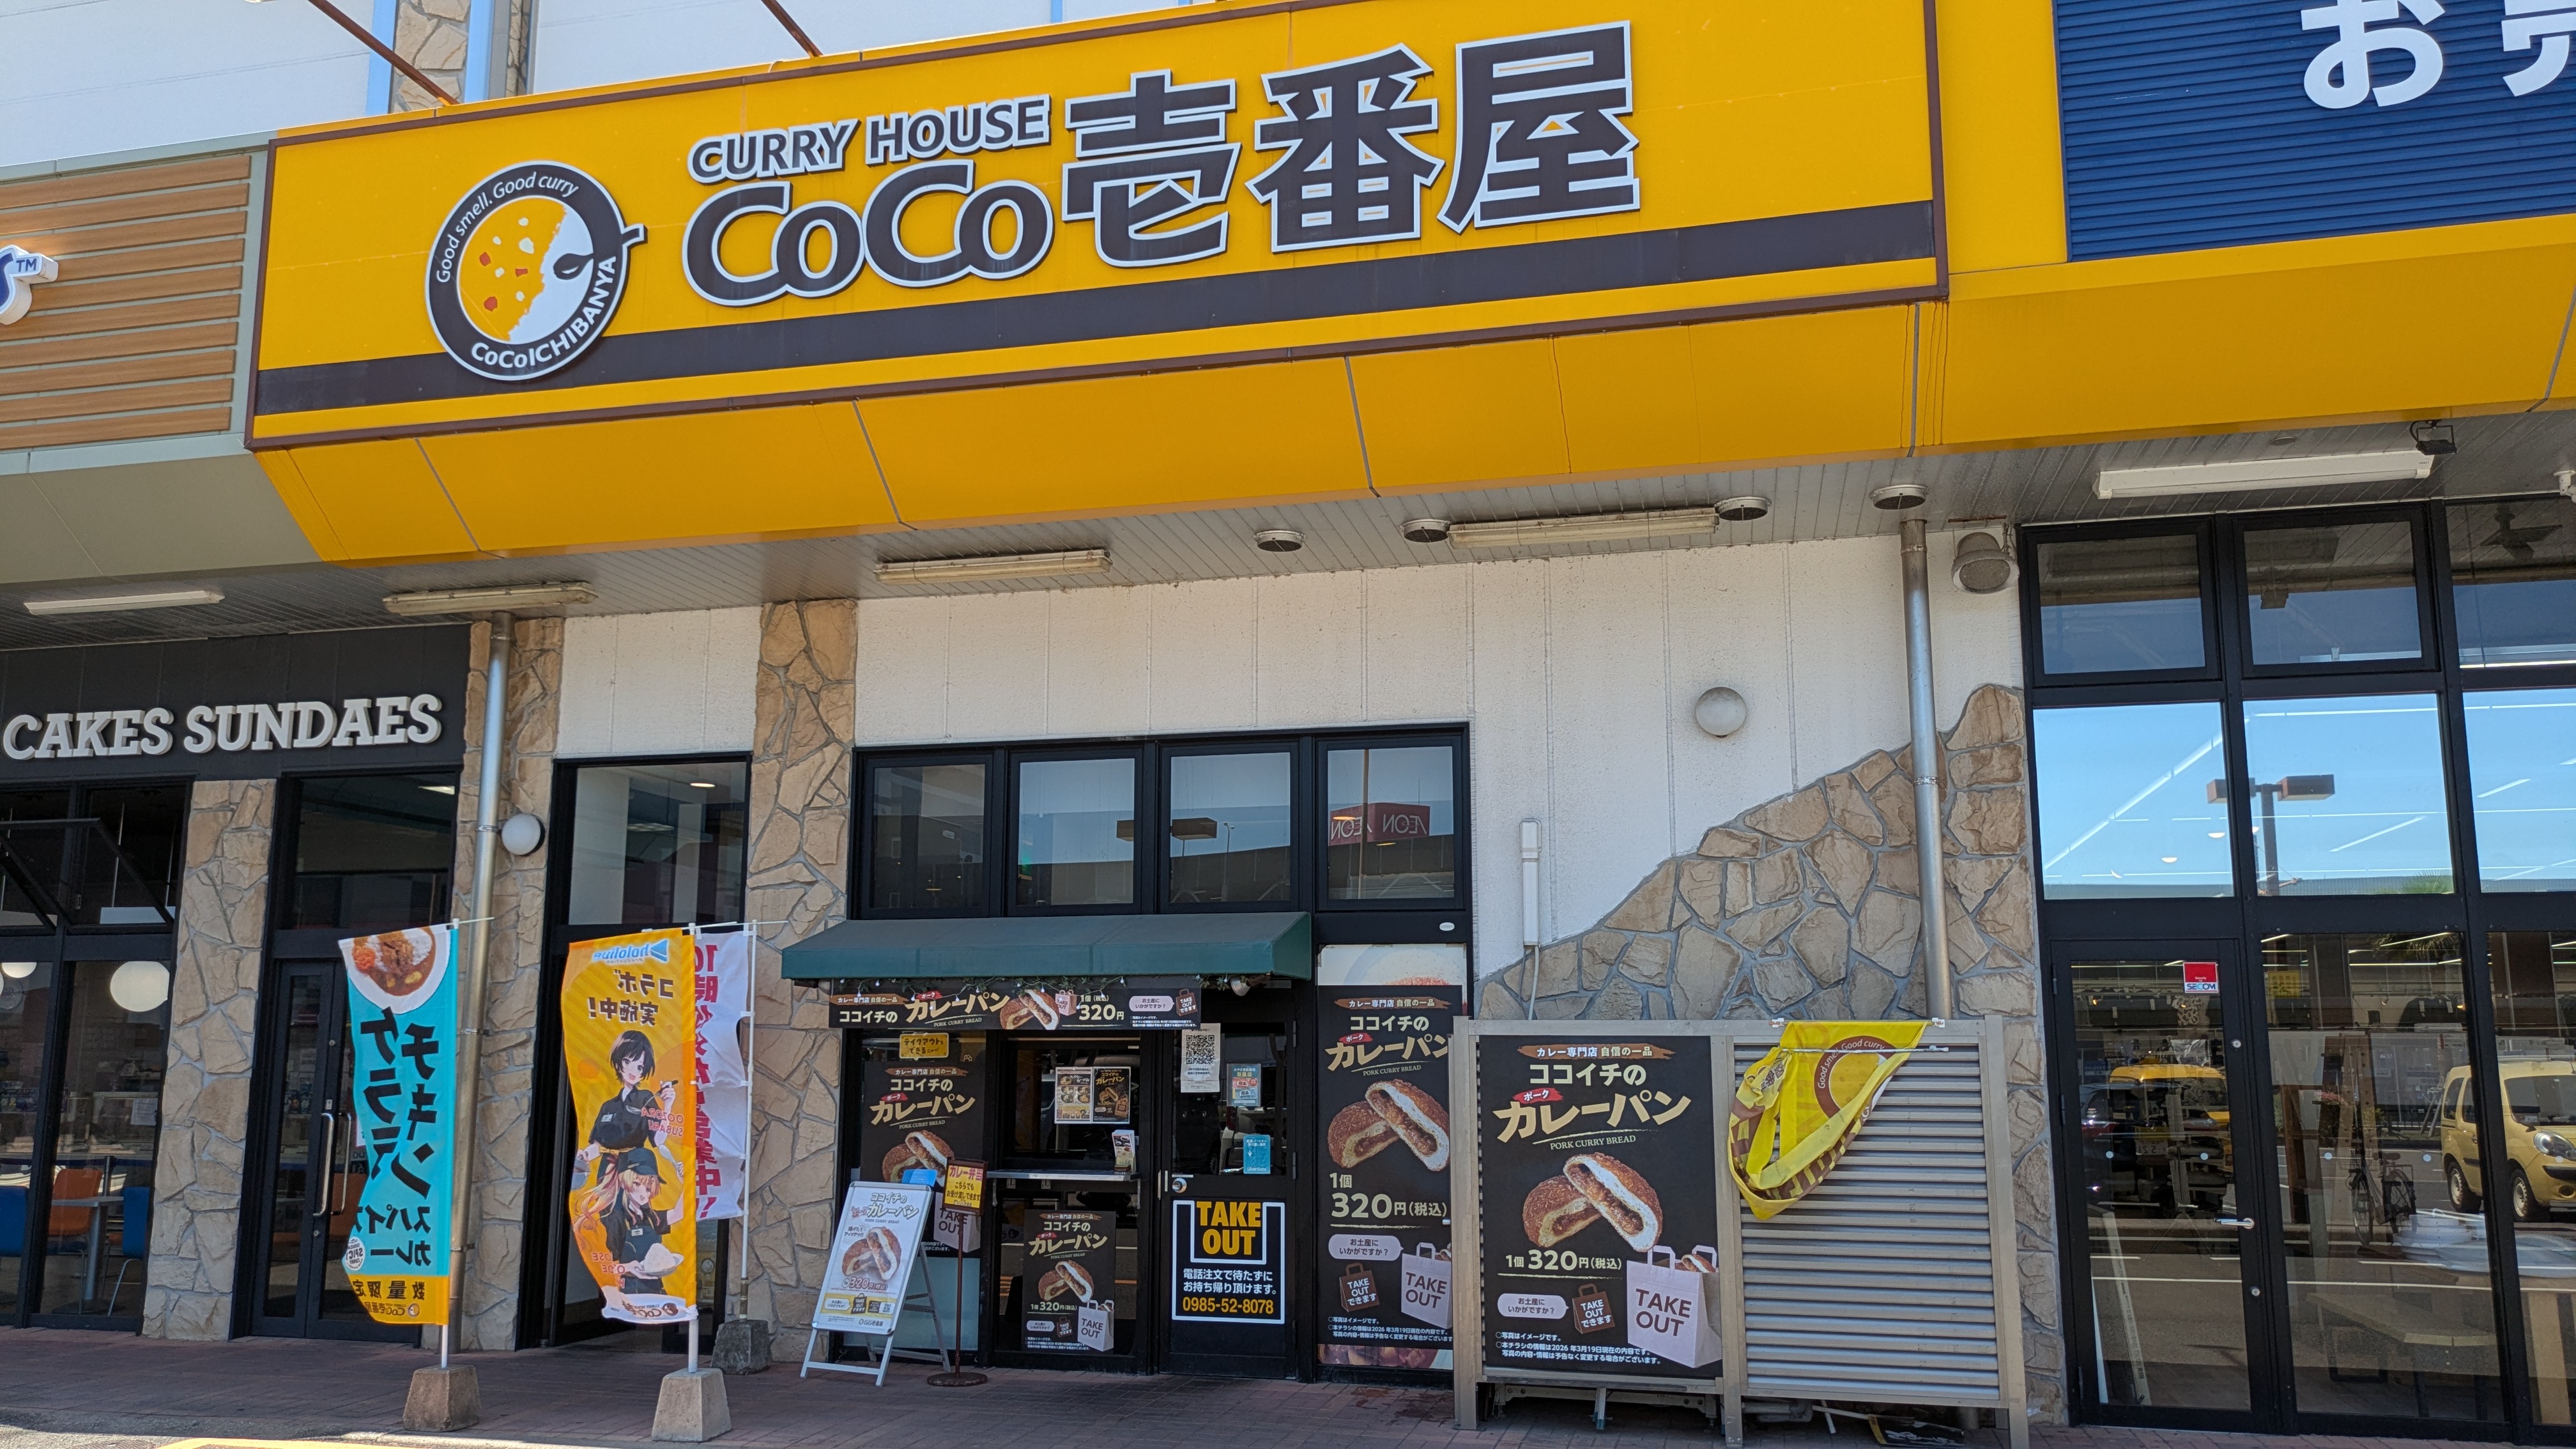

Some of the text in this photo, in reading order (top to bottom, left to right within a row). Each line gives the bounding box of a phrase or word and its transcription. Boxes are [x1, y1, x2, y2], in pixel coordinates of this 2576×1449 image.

[688, 93, 1052, 185] CURRY HOUSE
[436, 172, 579, 283] Good smell. Good curry
[2, 693, 443, 760] CAKES SUNDAES
[905, 992, 1010, 1023] カレーパン
[1179, 1005, 1197, 1013] できます
[1349, 999, 1435, 1008] カレー専門店 自信の一品
[839, 1010, 898, 1023] ココイチの
[1079, 1004, 1124, 1020] 320円
[1350, 1015, 1429, 1032] ココイチの
[1346, 1034, 1364, 1043] ポーク
[1324, 1033, 1448, 1071] カレーパン
[1537, 1046, 1653, 1057] カレー専門店 自信の一品
[1529, 1063, 1646, 1086] ココイチの
[890, 1078, 953, 1092] ココイチの
[1523, 1089, 1550, 1101] ポーク
[870, 1093, 976, 1126] カレーパン
[1492, 1089, 1692, 1143] カレーパン
[1550, 1135, 1636, 1150] PORK CURRY BREAD
[949, 1165, 983, 1181] カレー弁当
[1330, 1172, 1353, 1188] 1個
[955, 1182, 974, 1190] こちらでも
[871, 1192, 907, 1204] ココイチの
[867, 1202, 919, 1220] カレーパン
[1197, 1201, 1261, 1227] TAKE
[1043, 1222, 1091, 1232] ココイチの
[1028, 1233, 1108, 1256] カレーパン
[1202, 1229, 1255, 1255] OUT
[1350, 1238, 1379, 1246] お土産に
[1505, 1254, 1524, 1268] 1個
[1183, 1268, 1273, 1282] 電話注文で待たずに
[1183, 1281, 1276, 1295] お持ち帰り頂けます。
[1347, 1278, 1370, 1289] TAKE
[1351, 1286, 1369, 1296] OUT
[1406, 1272, 1448, 1295] TAKE
[1182, 1296, 1274, 1314] 0985-52-8078
[1347, 1292, 1377, 1307] できます
[1405, 1289, 1442, 1309] OUT
[1518, 1298, 1545, 1306] お土産に
[1581, 1299, 1604, 1310] TAKE
[1636, 1288, 1692, 1319] TAKE
[1585, 1307, 1604, 1319] OUT
[1082, 1317, 1104, 1331] TAKE
[1581, 1315, 1612, 1328] できます
[1636, 1311, 1685, 1337] OUT
[1081, 1328, 1100, 1338] OUT
